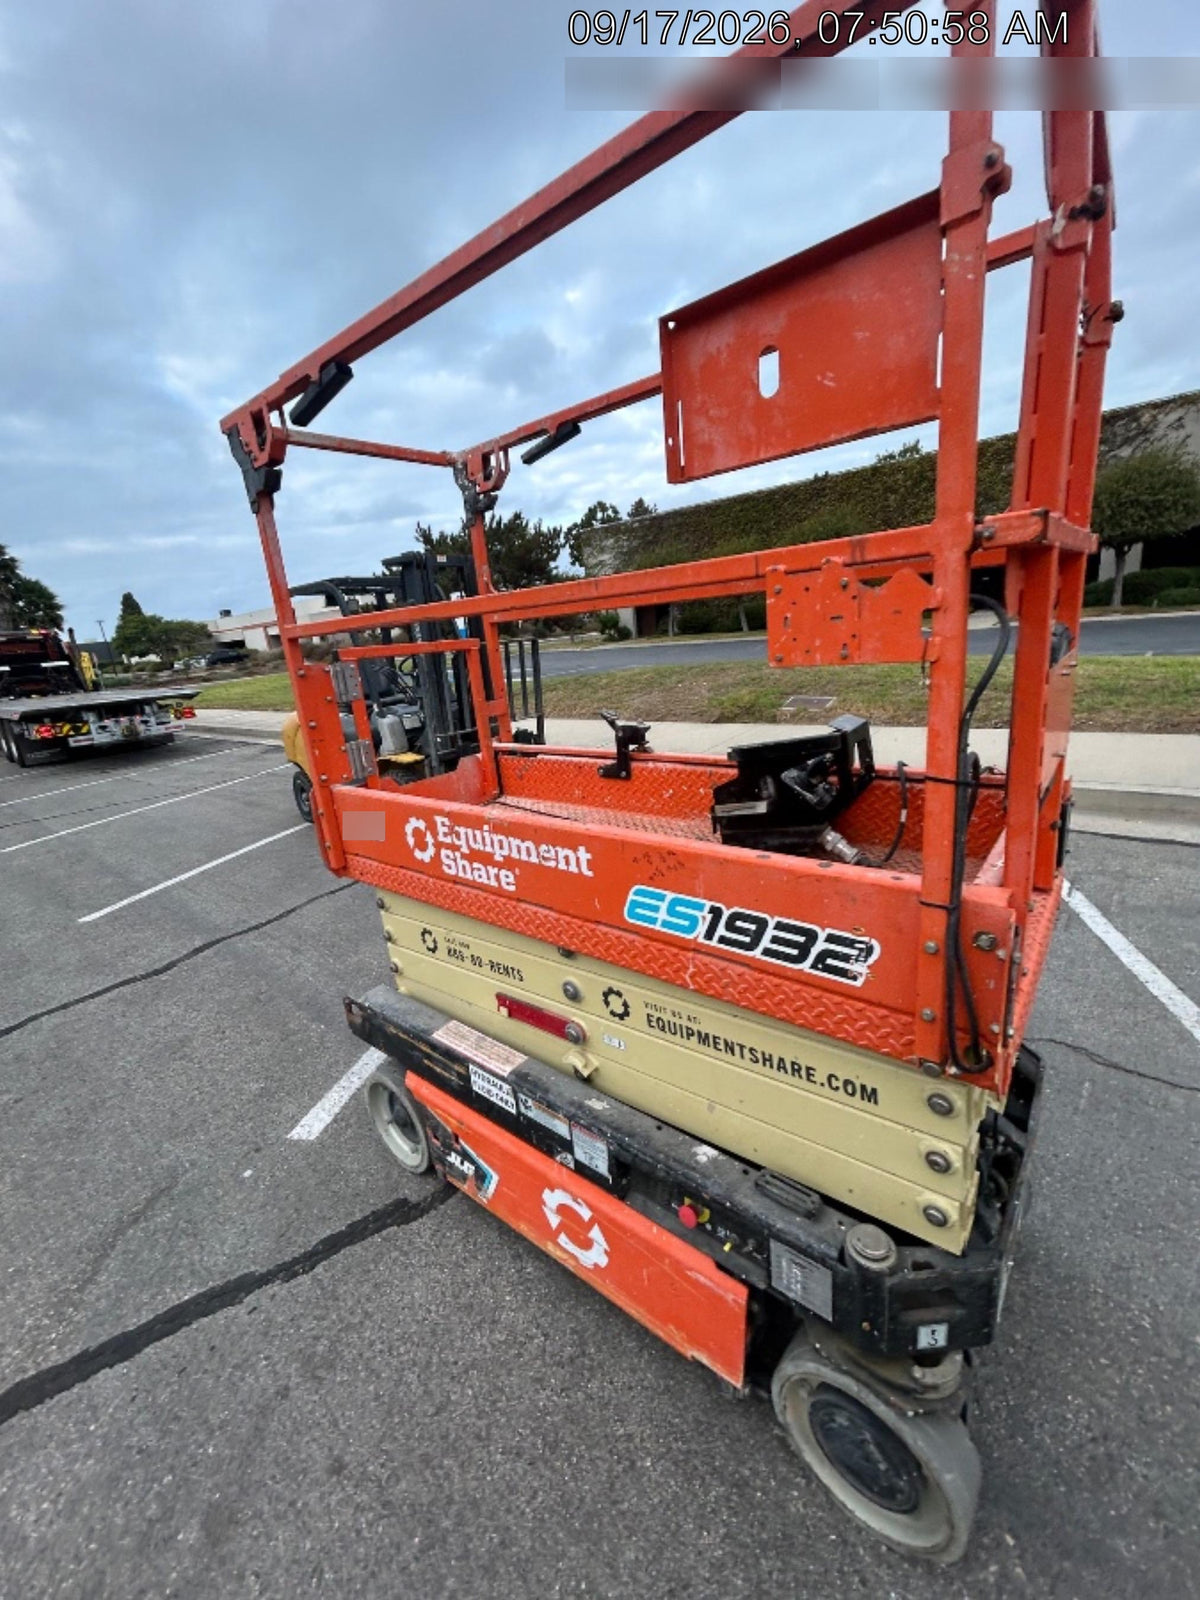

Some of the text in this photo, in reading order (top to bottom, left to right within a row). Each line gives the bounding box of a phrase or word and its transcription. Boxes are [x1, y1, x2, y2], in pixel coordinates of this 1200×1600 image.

[434, 815, 594, 878] Equipment
[439, 848, 516, 892] Share
[625, 886, 877, 983] ES1932
[646, 1012, 879, 1106] EQUIPMENTSHARE.COM
